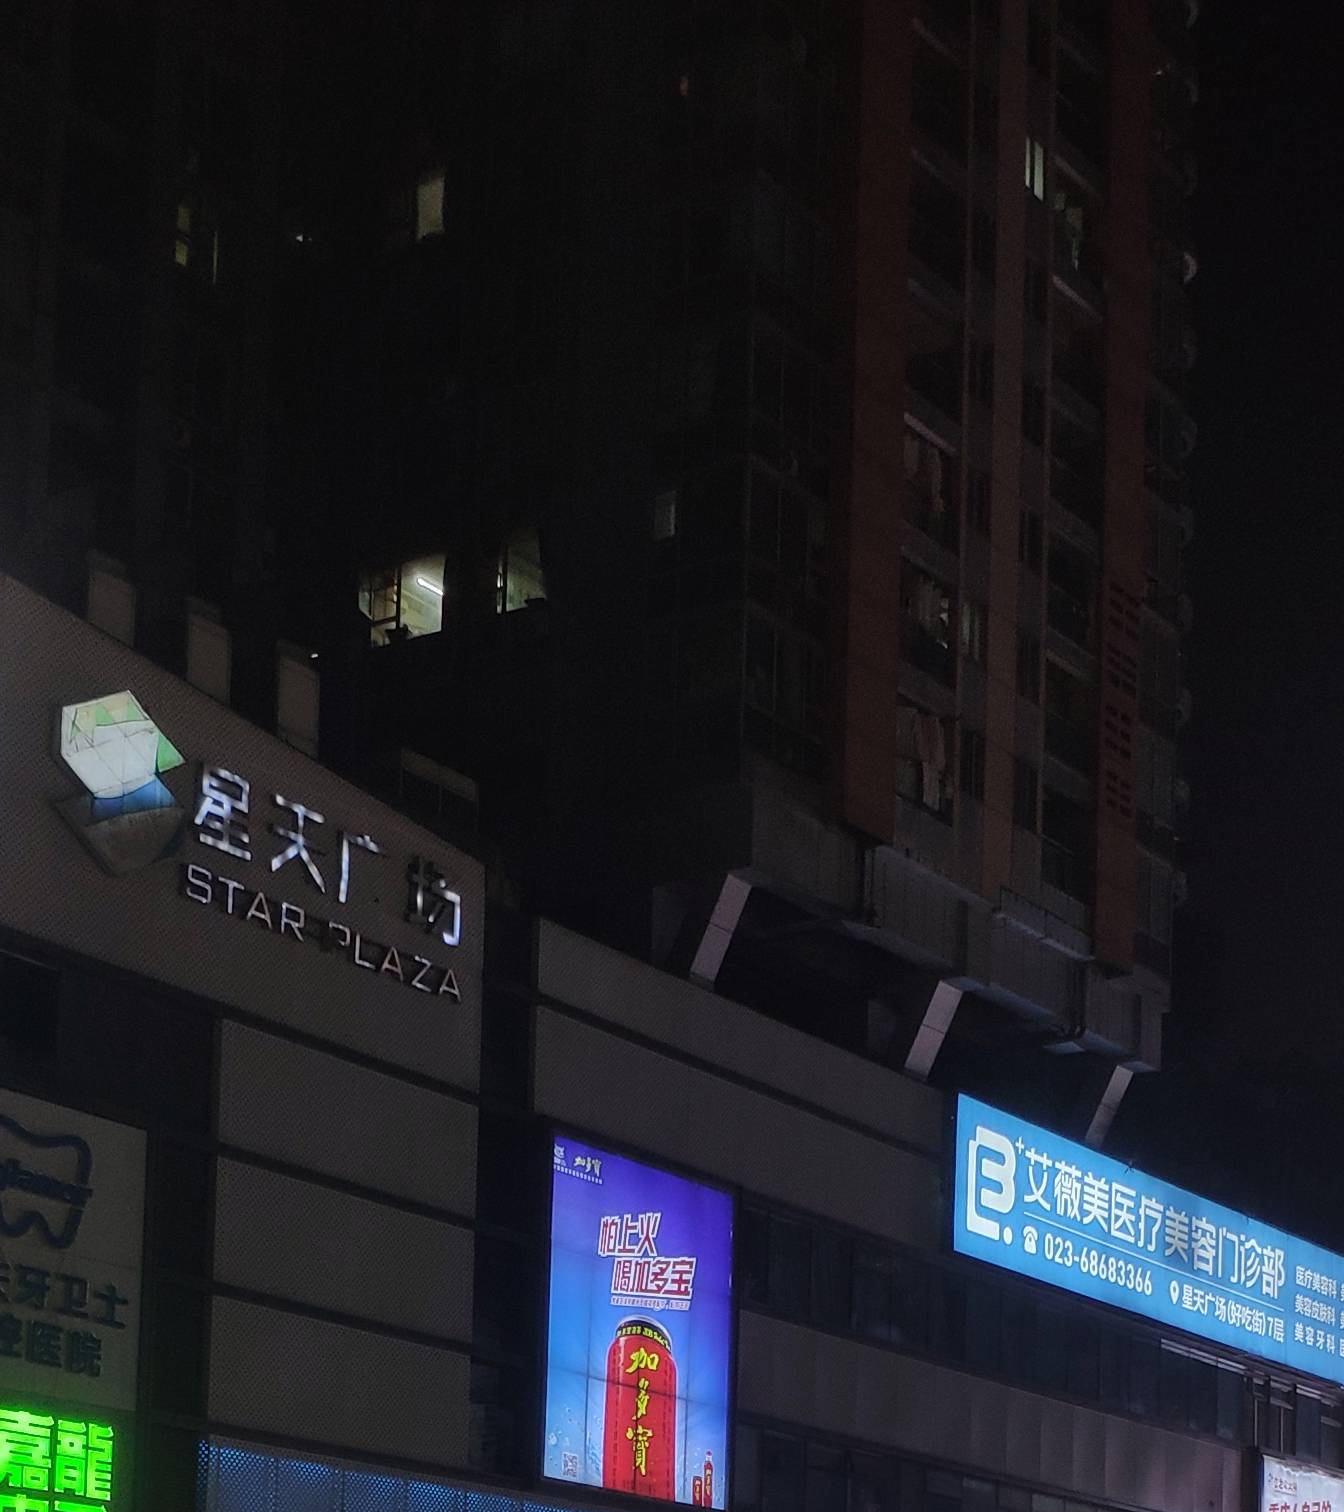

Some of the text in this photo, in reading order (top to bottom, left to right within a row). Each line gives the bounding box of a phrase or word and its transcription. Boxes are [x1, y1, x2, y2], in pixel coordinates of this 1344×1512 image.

[185, 861, 462, 1001] STAR PLAZA
[598, 1212, 661, 1257] 怕上火
[1024, 1147, 1285, 1300] 艾薇美医疗美容门诊部
[611, 1256, 696, 1299] 喝加多宝
[1044, 1234, 1152, 1296] 023-68683366
[1295, 1265, 1337, 1298] 医疗美容科
[1294, 1293, 1335, 1327] 美容皮肤科
[1294, 1321, 1335, 1354] 美容牙科
